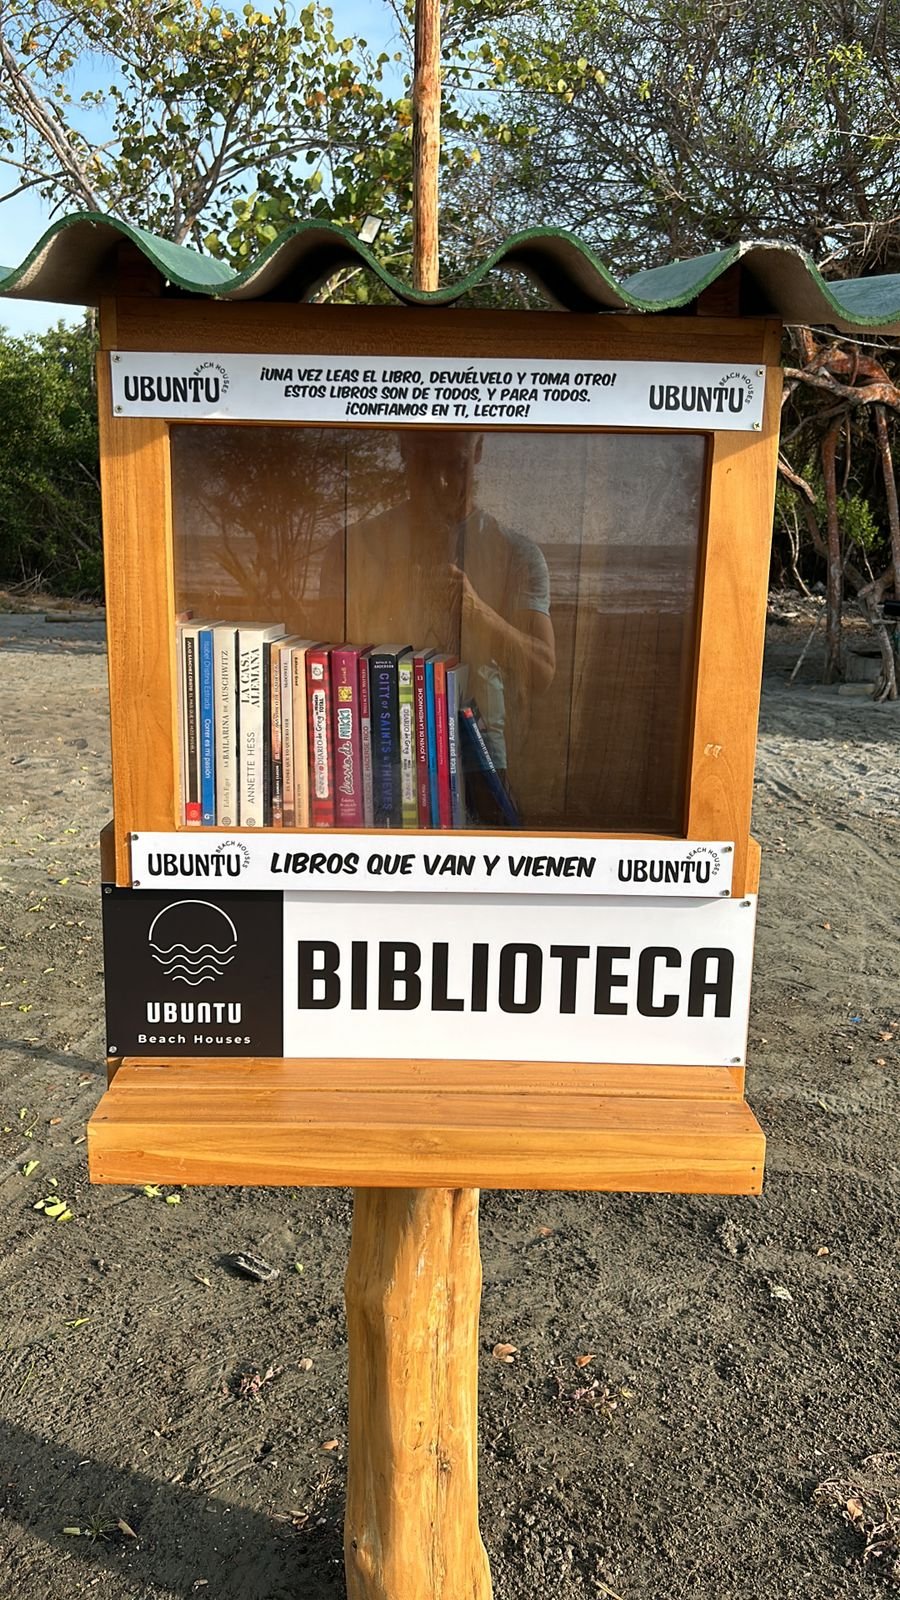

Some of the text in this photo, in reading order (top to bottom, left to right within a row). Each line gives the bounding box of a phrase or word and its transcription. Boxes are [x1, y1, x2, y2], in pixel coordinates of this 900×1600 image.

[124, 375, 220, 403] UBUNTU
[193, 361, 230, 393] BEACH HOUSES
[260, 366, 617, 386] ¡UNA VEZ LEAS EL LIBRO, DEVUÉLVELO Y TOMA OTRO!
[719, 372, 753, 404] BEACH HOUSES
[284, 385, 591, 403] ESTOS LIBROS SON DE TODOS, Y PARA TODOS.
[649, 384, 744, 413] UBUNTU
[345, 401, 530, 419] ¡CONFIAMOS EN TI, LECTOR!
[203, 660, 211, 685] Cristina
[221, 650, 229, 703] AUSCHWITZ
[241, 651, 250, 703] LA CASA
[250, 648, 260, 708] ALEMANA
[379, 672, 391, 699] CITY
[204, 685, 212, 709] Estrada
[204, 718, 212, 738] Correr
[315, 715, 324, 732] Greg
[338, 708, 352, 739] NIKKI
[380, 712, 392, 753] SAINTS
[448, 716, 456, 741] Amador
[338, 740, 353, 756] de
[403, 740, 411, 755] Greg
[449, 742, 457, 757] para
[204, 757, 212, 778] pasión
[247, 732, 256, 804] ANNETTE HESS
[339, 756, 354, 795] diario
[381, 763, 393, 810] THIEVES
[147, 853, 241, 877] UBUNTU
[215, 840, 251, 869] BEACH HOUSES
[270, 852, 597, 878] LIBROS QUE VAN Y VIENEN
[686, 847, 721, 876] BEACH HOUSES
[617, 859, 711, 884] UBUNTU
[297, 940, 735, 1018] BIBLIOTECA
[146, 1002, 242, 1024] UBUNTU
[138, 1034, 251, 1044] Beach Houses
